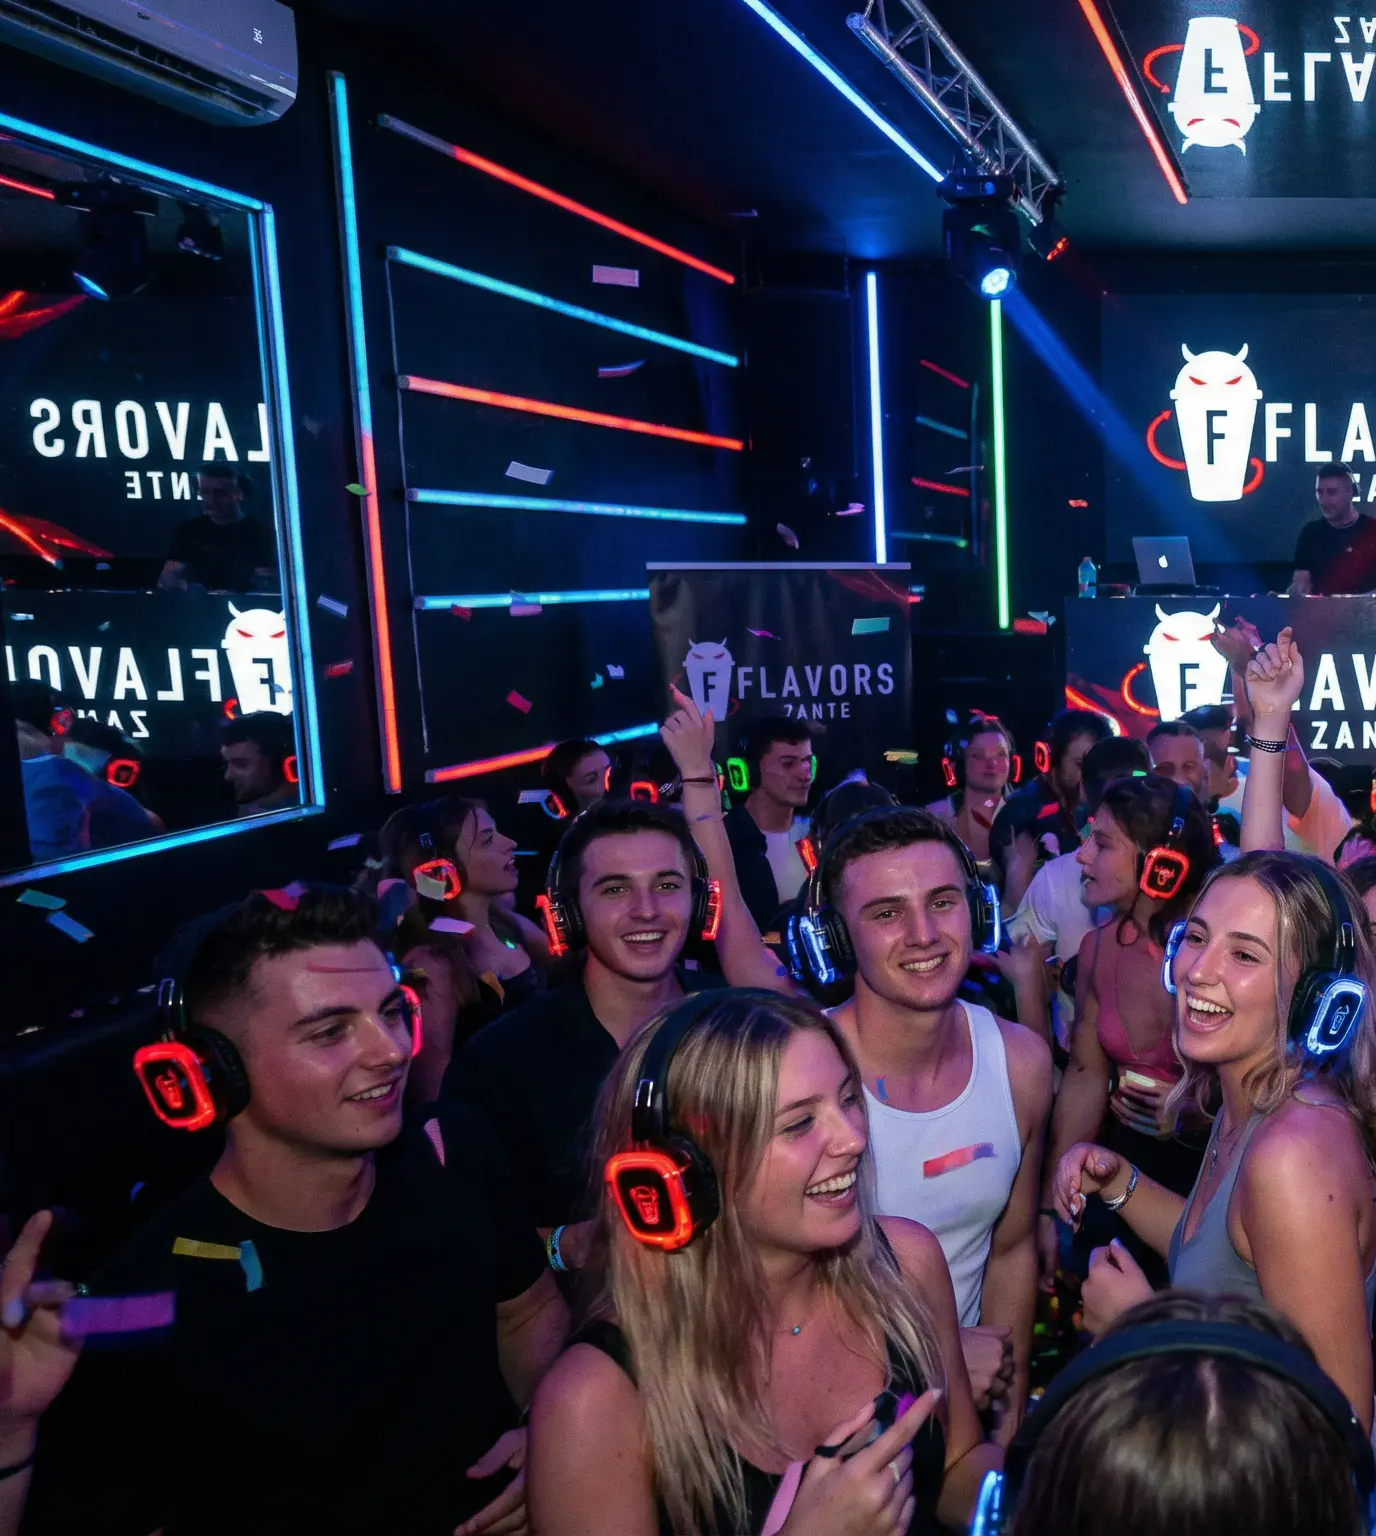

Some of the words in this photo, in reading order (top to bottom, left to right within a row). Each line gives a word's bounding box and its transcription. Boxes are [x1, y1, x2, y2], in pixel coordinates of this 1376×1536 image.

[1206, 409, 1228, 465] F
[737, 663, 895, 699] FLAVORS
[1179, 663, 1200, 713] F
